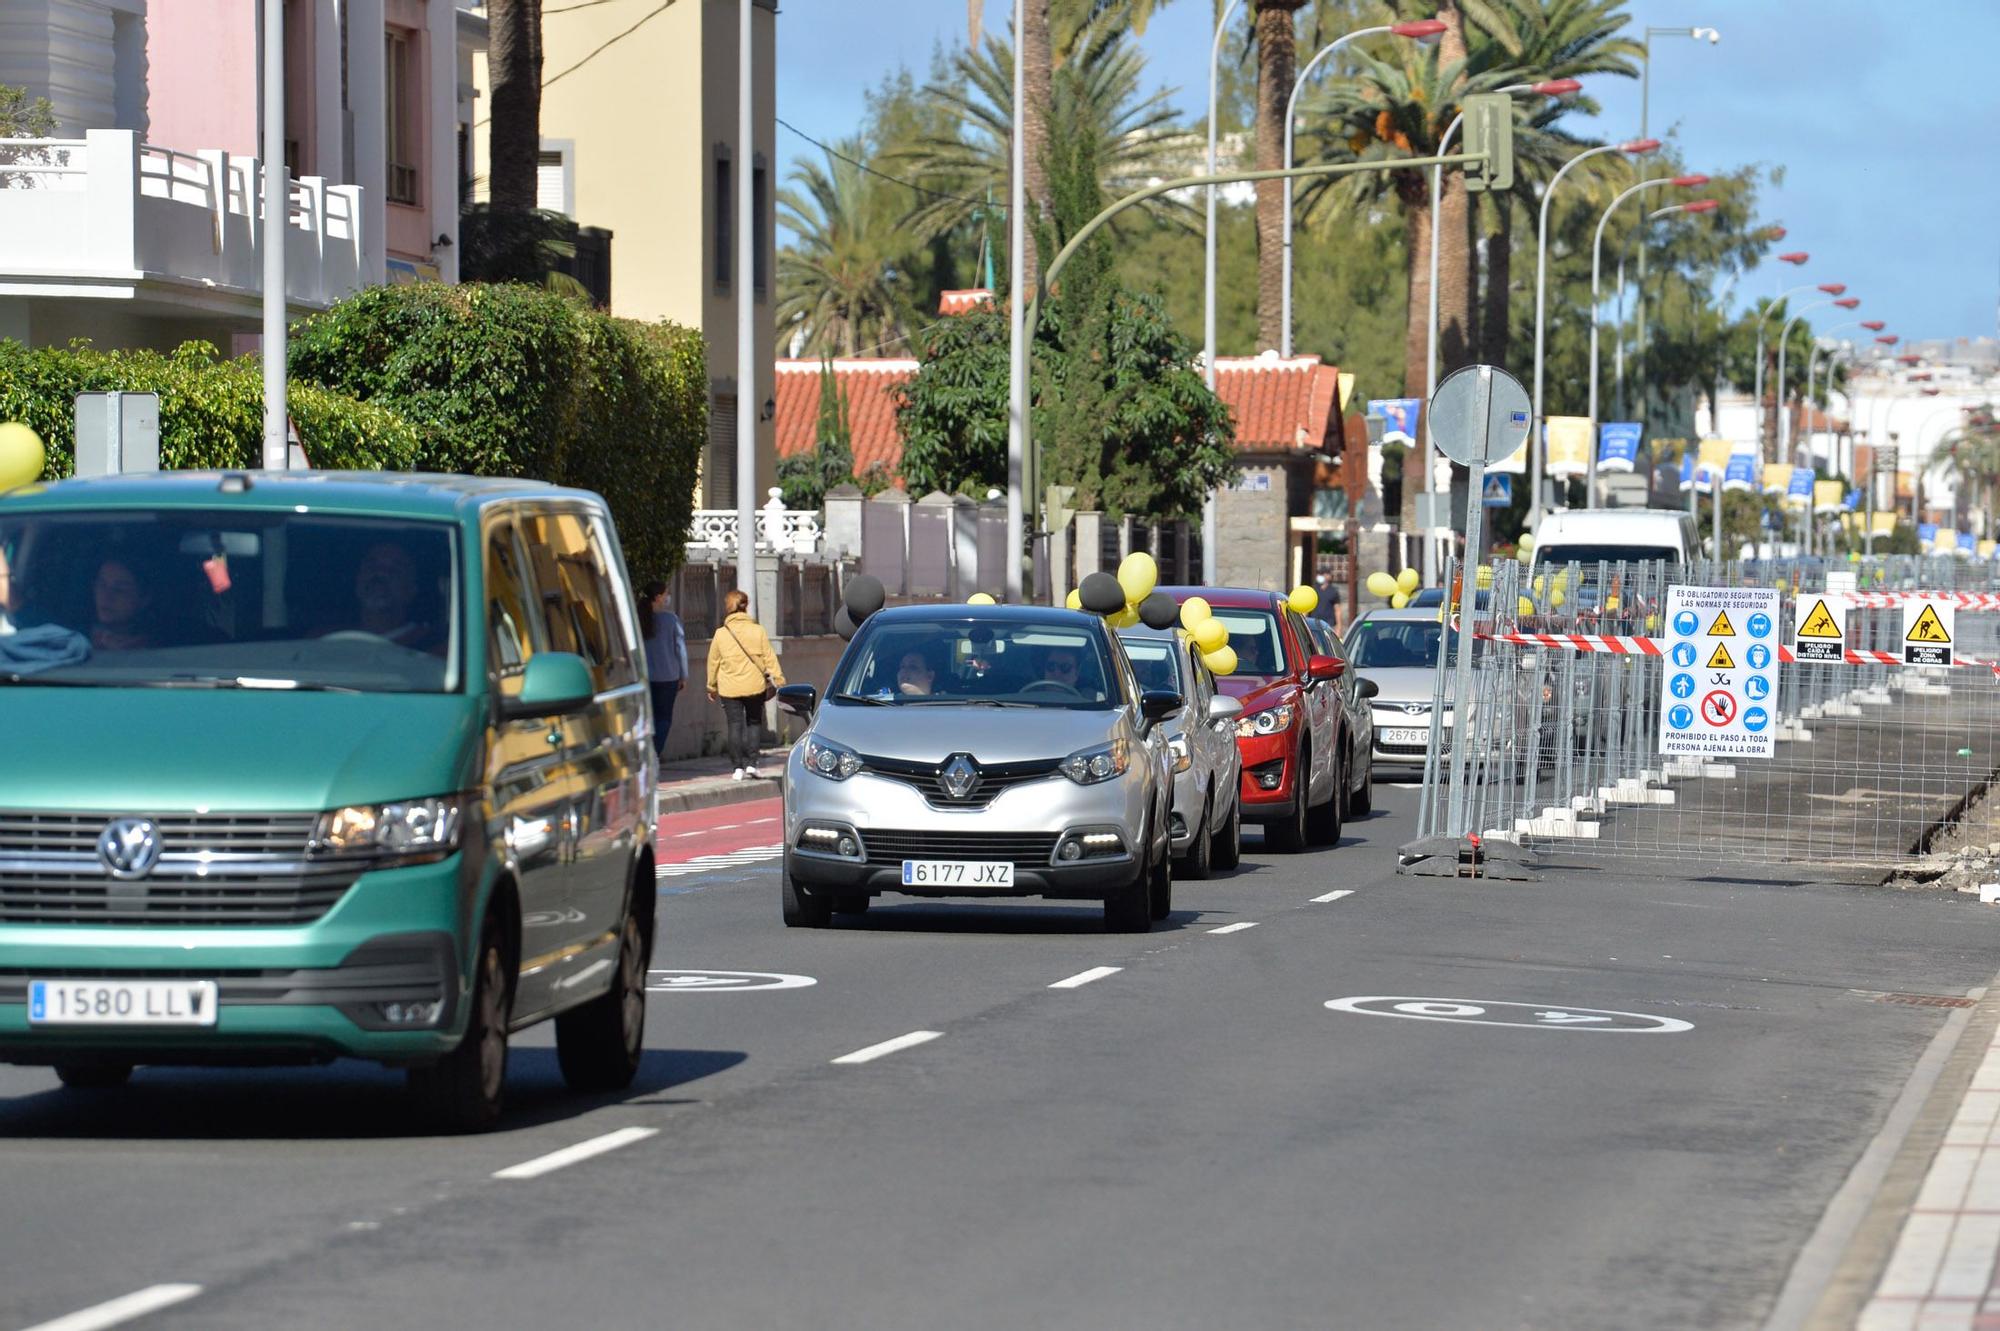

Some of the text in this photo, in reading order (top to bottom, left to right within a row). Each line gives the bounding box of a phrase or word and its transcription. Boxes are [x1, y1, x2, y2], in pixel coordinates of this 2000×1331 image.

[1676, 589, 1685, 598] ES
[1687, 590, 1729, 600] OBLIGATORIO
[1730, 592, 1753, 600] SEGUIR
[1681, 599, 1694, 607] LAS
[1695, 600, 1721, 608] NORMAS
[1732, 601, 1768, 609] SEGURIDAD
[1388, 730, 1417, 741] 2676
[1665, 732, 1707, 741] PROHIBIDO
[1720, 734, 1740, 742] PASO
[1666, 742, 1701, 751] PERSONA
[1702, 744, 1726, 752] AJENA
[1735, 745, 1744, 753] LA
[1746, 746, 1766, 754] OBRA
[916, 864, 965, 882] 6177
[973, 865, 1009, 883] JXZ
[57, 987, 133, 1016] 1580
